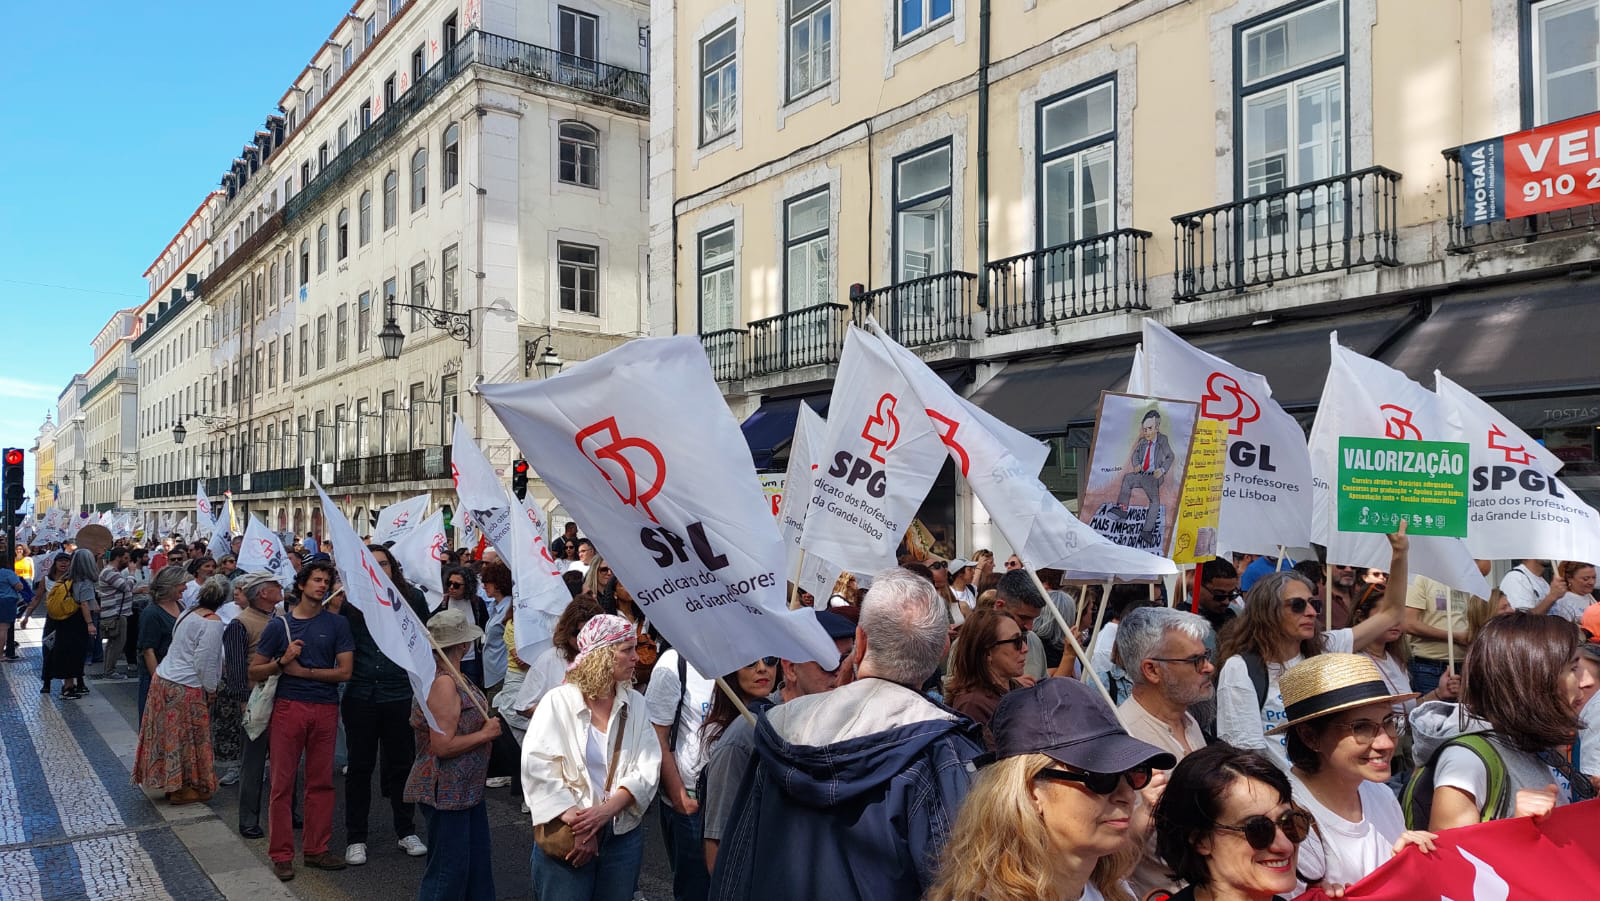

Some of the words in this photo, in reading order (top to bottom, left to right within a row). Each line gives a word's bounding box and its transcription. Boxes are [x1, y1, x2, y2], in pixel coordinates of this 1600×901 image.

[1518, 126, 1600, 173] VE
[1472, 146, 1487, 221] IMORAIA
[1523, 174, 1576, 202] 910
[1544, 407, 1599, 419] TOSTAS
[1229, 440, 1277, 473] GL
[1343, 448, 1464, 478] VALORIZAÇÃO
[828, 450, 887, 499] SPG
[1233, 472, 1300, 493] Professores
[1472, 465, 1565, 500] SPGL
[844, 490, 859, 508] dos
[1239, 488, 1277, 502] Lisboa
[1498, 496, 1520, 505] dos
[1524, 496, 1590, 519] Professores
[812, 495, 825, 507] da
[827, 501, 858, 525] Grande
[858, 519, 883, 541] Lisboa
[1471, 512, 1484, 521] da
[1486, 510, 1527, 521] Grande
[1530, 511, 1570, 524] Lisboa
[640, 521, 730, 572] SPL
[685, 596, 702, 613] da
